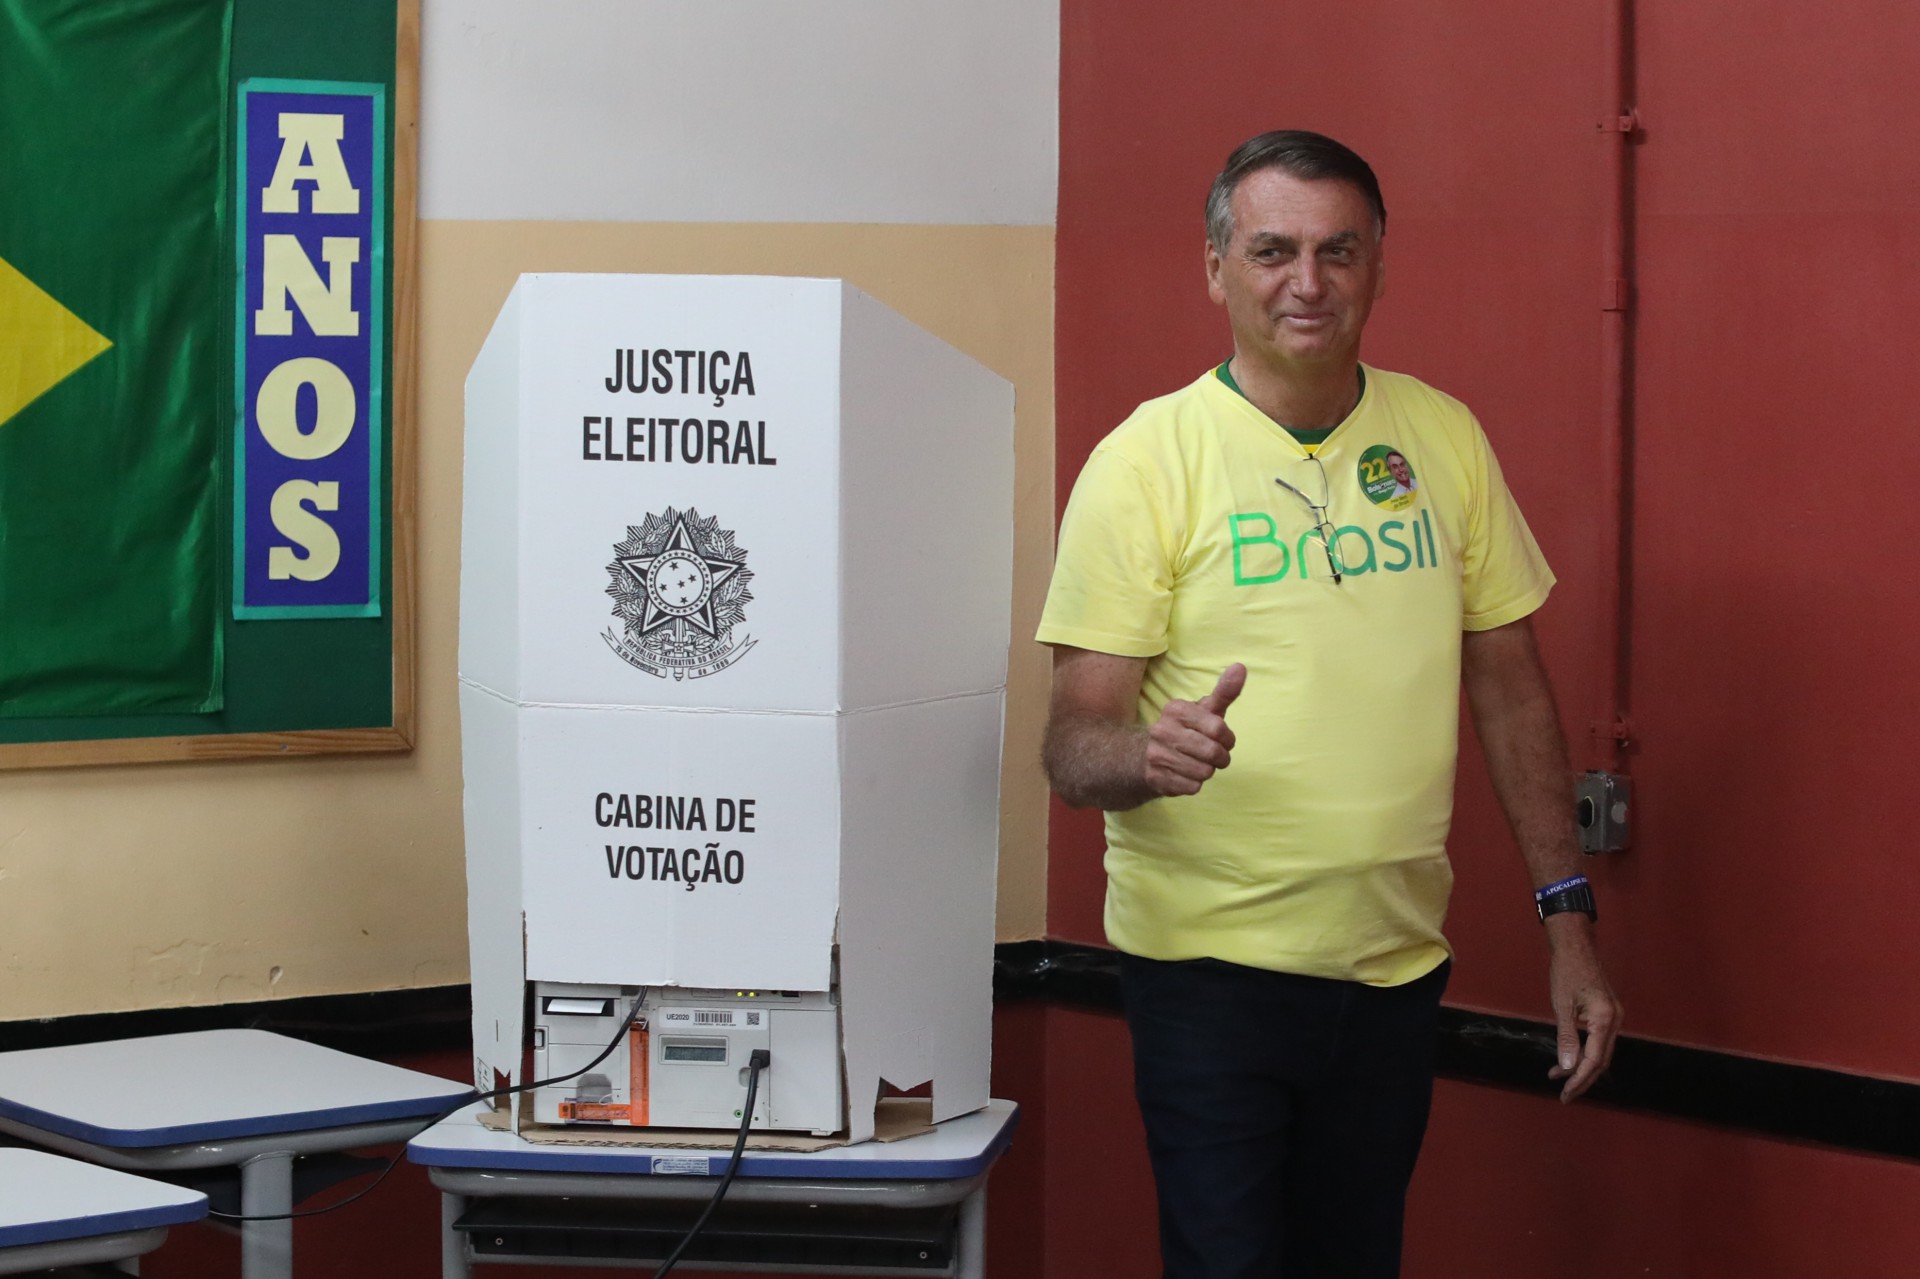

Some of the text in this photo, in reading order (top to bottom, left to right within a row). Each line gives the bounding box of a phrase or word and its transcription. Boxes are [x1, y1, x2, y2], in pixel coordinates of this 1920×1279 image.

[255, 112, 360, 582] ANOS
[605, 348, 756, 408] JUSTIÇA
[583, 416, 777, 465] ELEITORAL
[1361, 457, 1391, 483] 22
[1228, 508, 1438, 586] Brasil
[658, 656, 696, 666] FEDERATIVA
[708, 644, 732, 660] BRASIL
[595, 792, 756, 833] CABINA DE
[605, 842, 744, 891] VOTAÇÃO
[666, 1013, 689, 1021] UE2020
